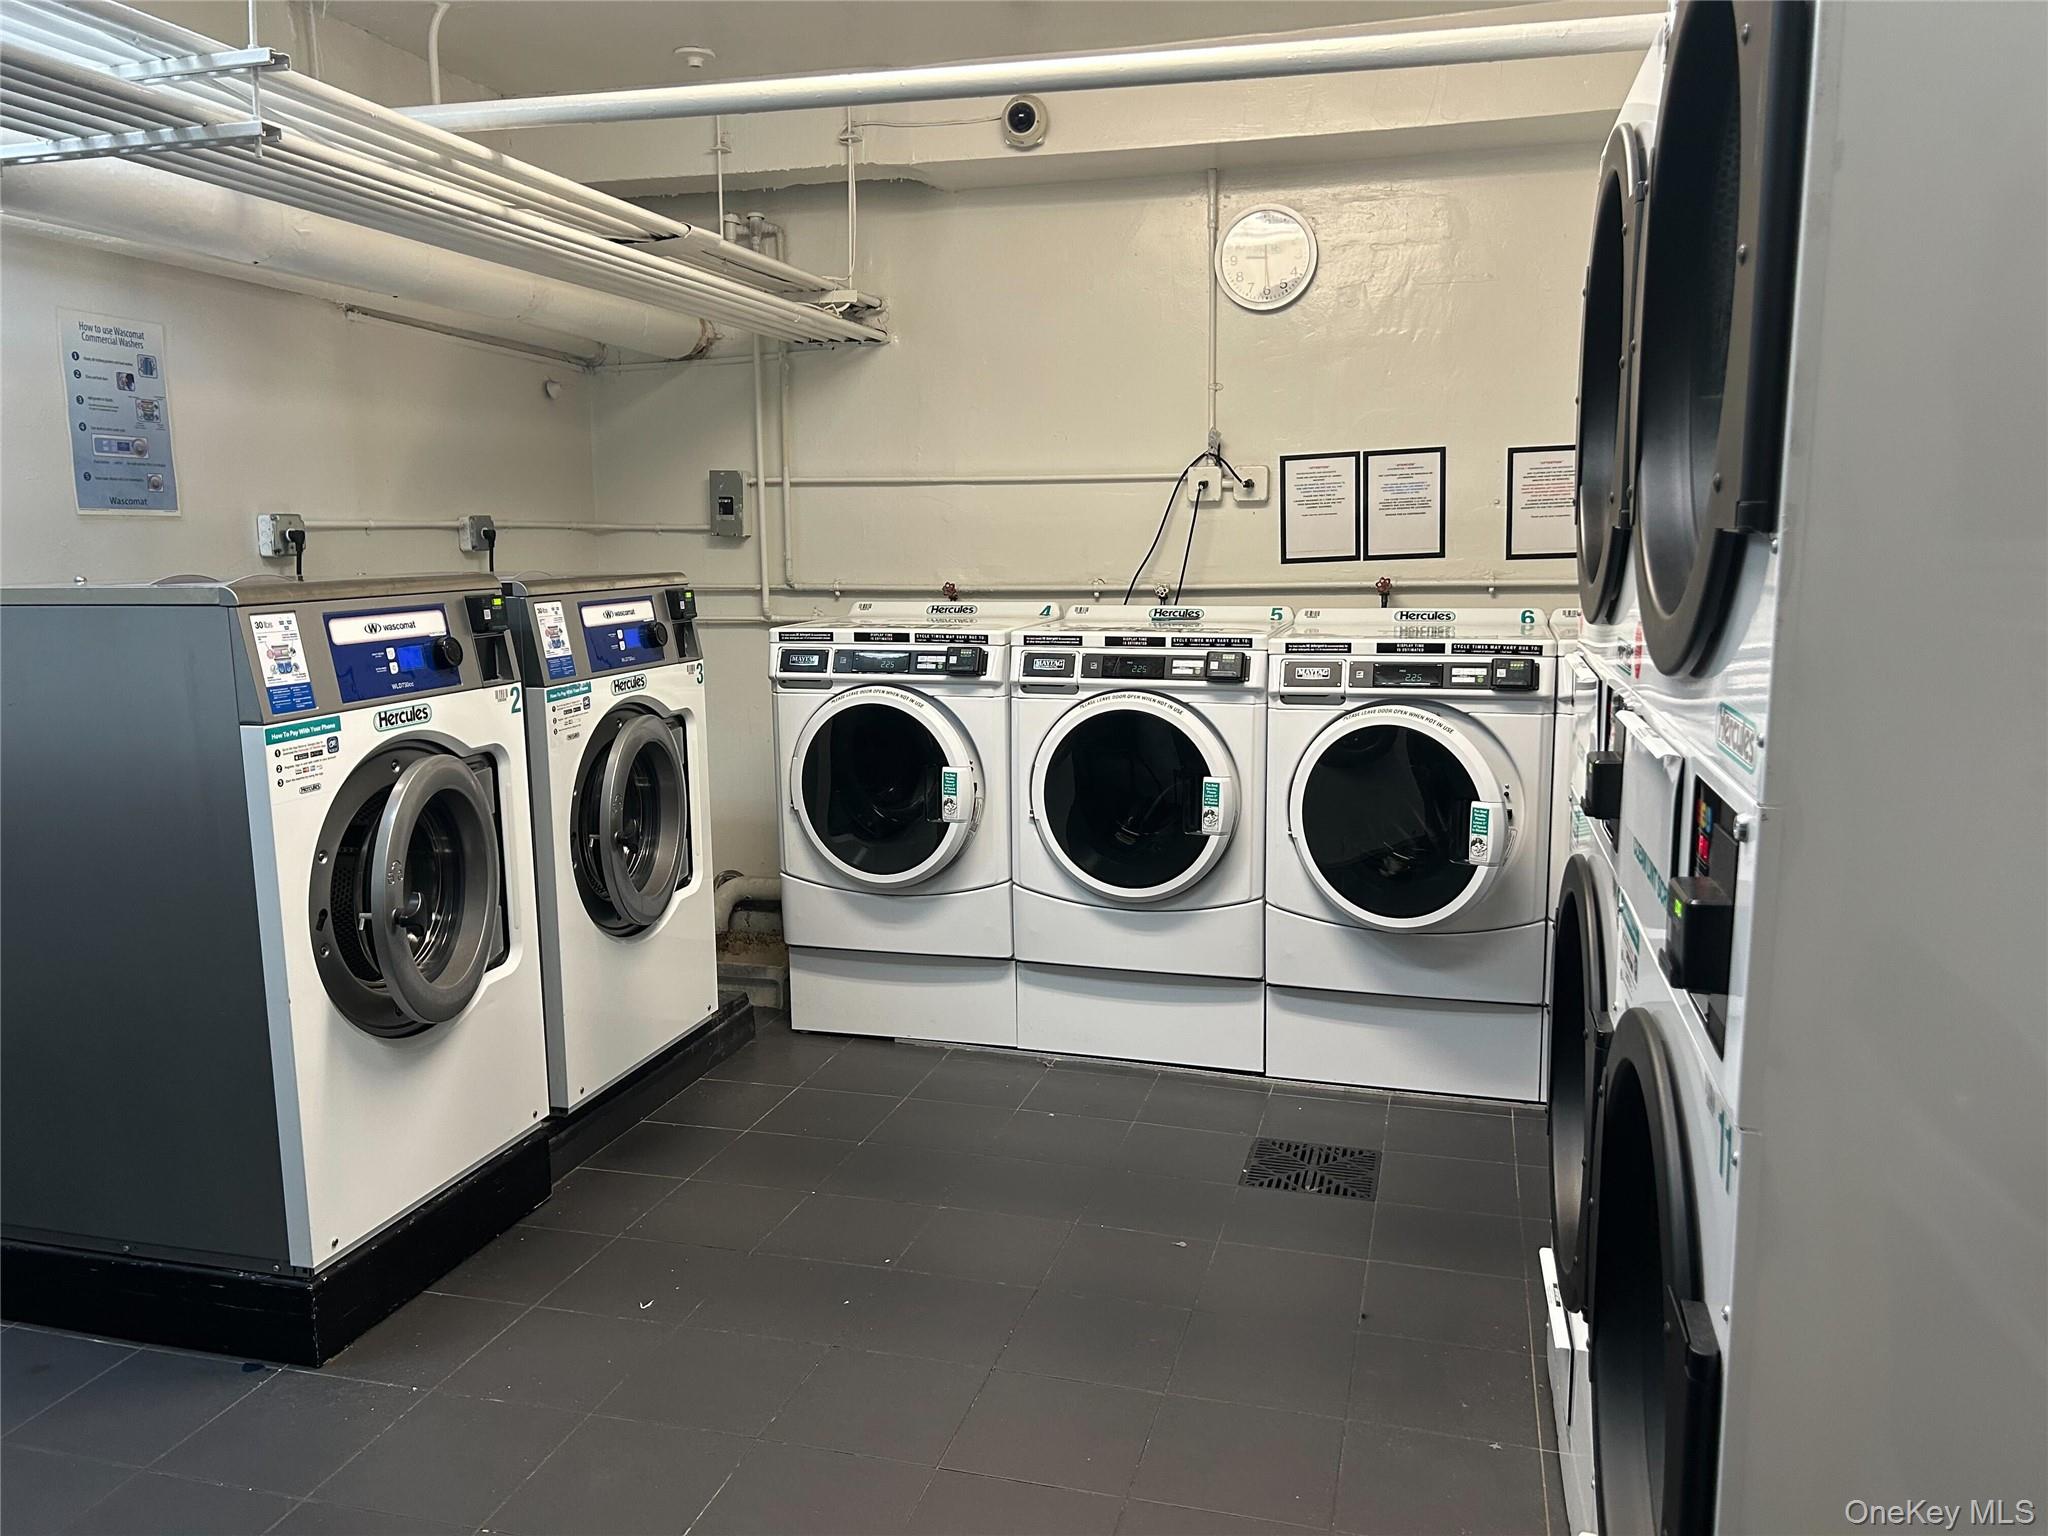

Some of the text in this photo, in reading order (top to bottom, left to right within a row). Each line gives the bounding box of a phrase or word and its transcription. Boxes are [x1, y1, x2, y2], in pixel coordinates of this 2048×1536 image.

[1290, 266, 1298, 276] 4
[1236, 272, 1244, 282] 8
[1248, 282, 1255, 292] 7
[1280, 280, 1288, 289] 5
[79, 321, 93, 332] How
[95, 325, 101, 333] to
[113, 327, 144, 340] Wascomat
[82, 332, 144, 349] Commercial Washers
[109, 497, 148, 505] Wascomat
[931, 606, 974, 614] Hercules
[1040, 605, 1051, 616] 4
[1154, 608, 1200, 617] Hercules
[1270, 608, 1283, 620] 5
[1400, 611, 1451, 620] Hercules
[1521, 610, 1535, 624] 6
[383, 621, 416, 631] wascomat
[696, 663, 703, 684] 3
[614, 675, 645, 692] Hercules
[510, 686, 521, 713] 2
[831, 694, 845, 703] PLEASE
[1080, 700, 1096, 709] PLEASE
[1174, 707, 1183, 715] USE
[378, 706, 428, 727] Hercules
[1343, 712, 1360, 720] PLEASE
[1408, 712, 1424, 720] WHEN
[1442, 725, 1454, 735] USE
[1719, 1110, 1732, 1196] 11
